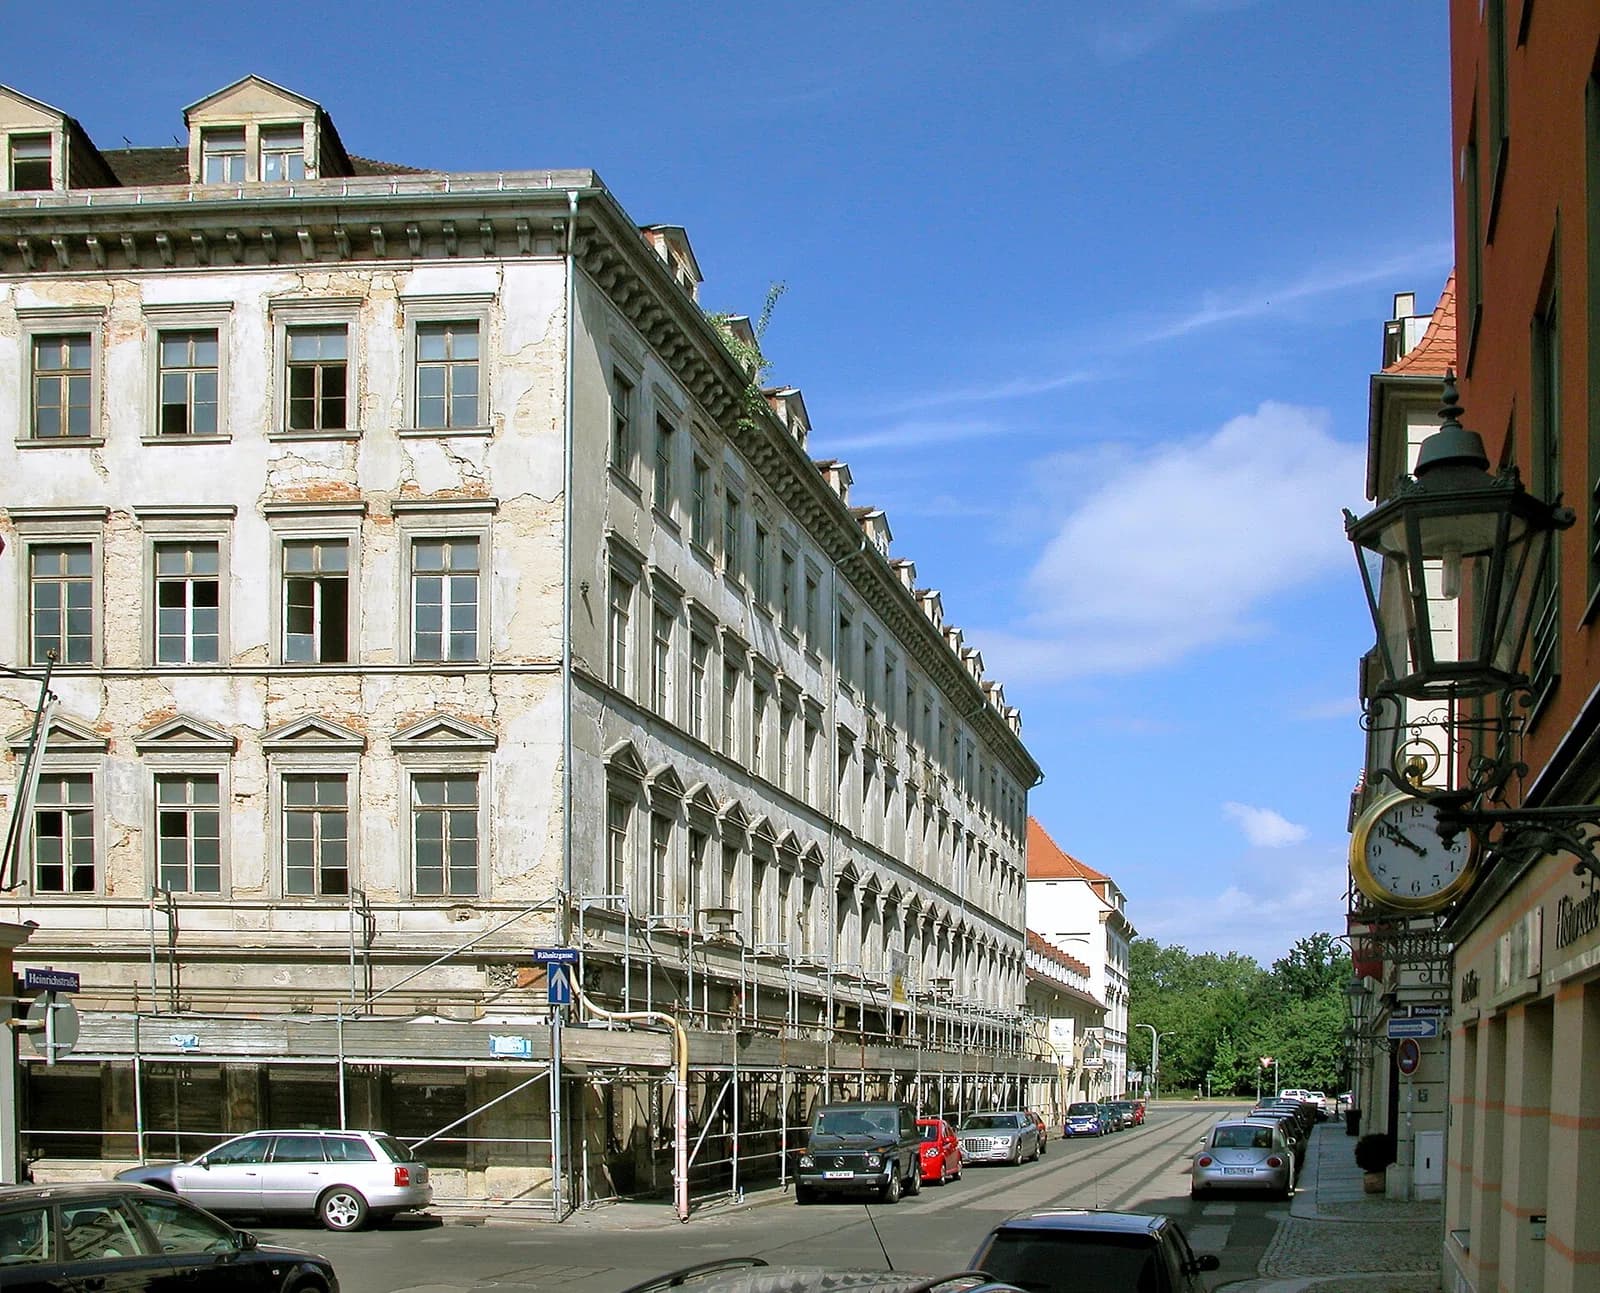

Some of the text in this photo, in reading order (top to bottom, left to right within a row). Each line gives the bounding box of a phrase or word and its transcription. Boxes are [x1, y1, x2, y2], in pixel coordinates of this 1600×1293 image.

[1395, 811, 1403, 823] 11
[1412, 804, 1424, 817] 12
[1372, 844, 1382, 857] 9
[1377, 862, 1387, 875] 8
[1391, 876, 1400, 889] 7
[1411, 880, 1421, 893] 6
[1431, 874, 1440, 886] 5
[28, 972, 78, 987] Heinrichstraße
